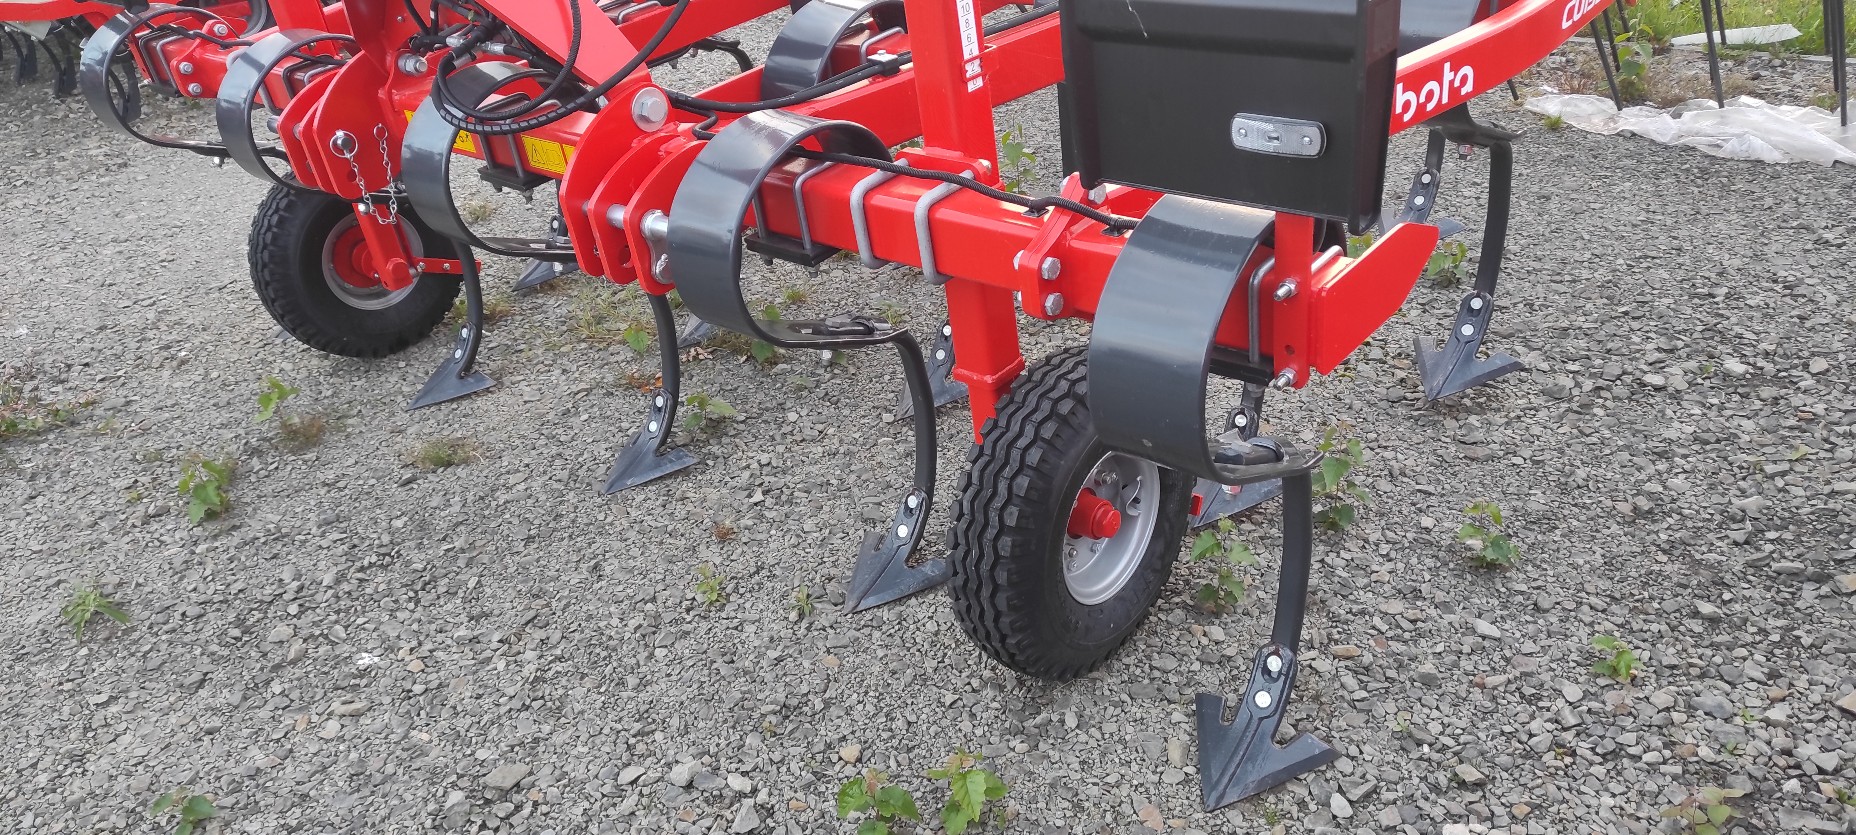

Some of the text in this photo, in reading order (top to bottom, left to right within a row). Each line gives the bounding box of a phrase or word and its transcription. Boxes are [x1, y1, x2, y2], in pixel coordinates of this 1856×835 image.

[960, 2, 971, 14] 10
[964, 18, 970, 29] 8
[966, 33, 972, 43] 6
[968, 48, 974, 58] 4
[970, 62, 976, 72] 2
[1395, 61, 1474, 122] bota
